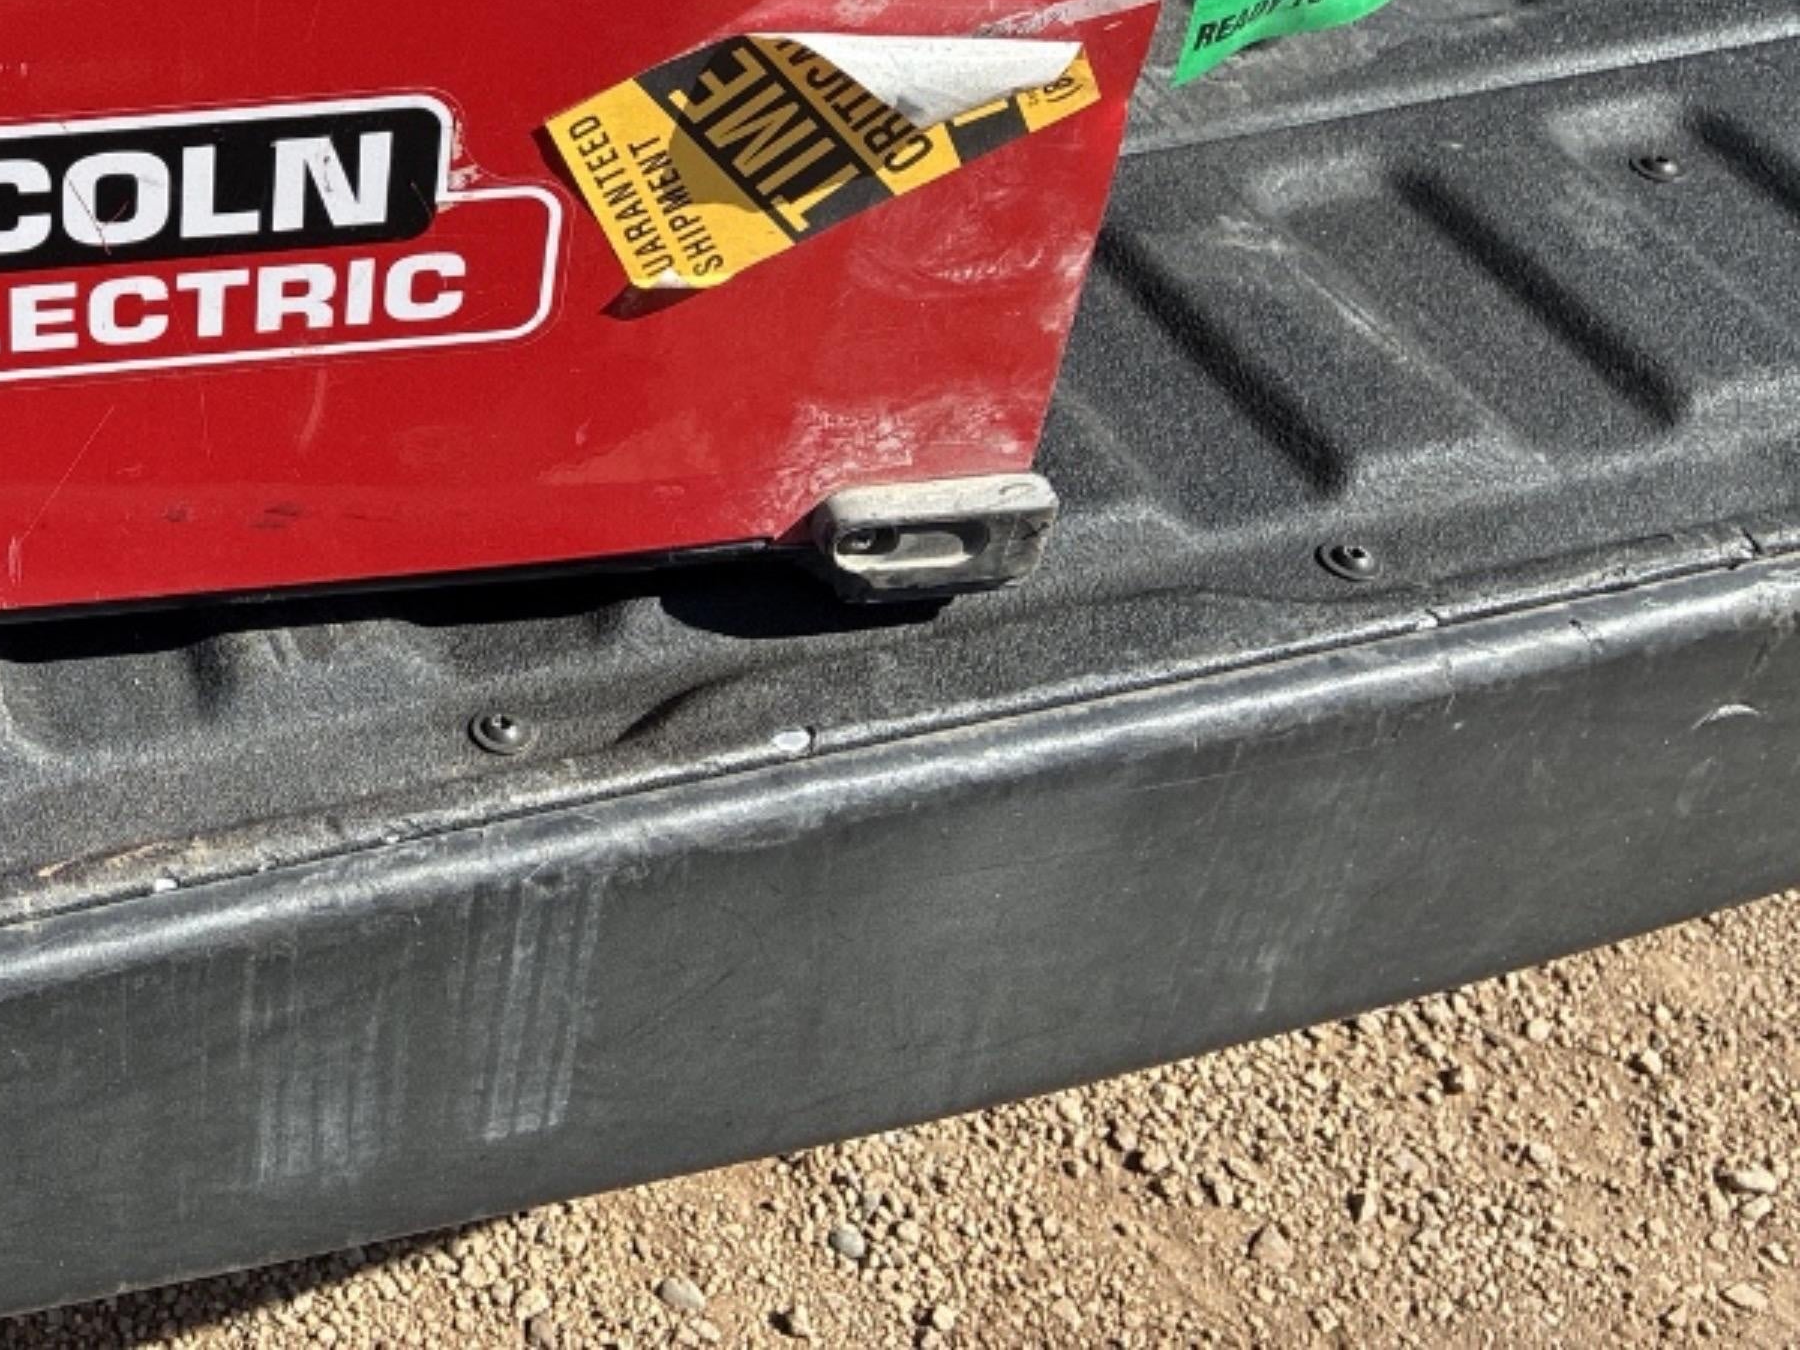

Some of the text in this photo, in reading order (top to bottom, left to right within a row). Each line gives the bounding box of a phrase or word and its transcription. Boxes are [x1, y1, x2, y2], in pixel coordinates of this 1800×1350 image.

[668, 46, 863, 234] TIME
[774, 39, 934, 174] CRITICA
[568, 114, 676, 279] UARANTEED
[627, 136, 725, 277] SHIPMENT
